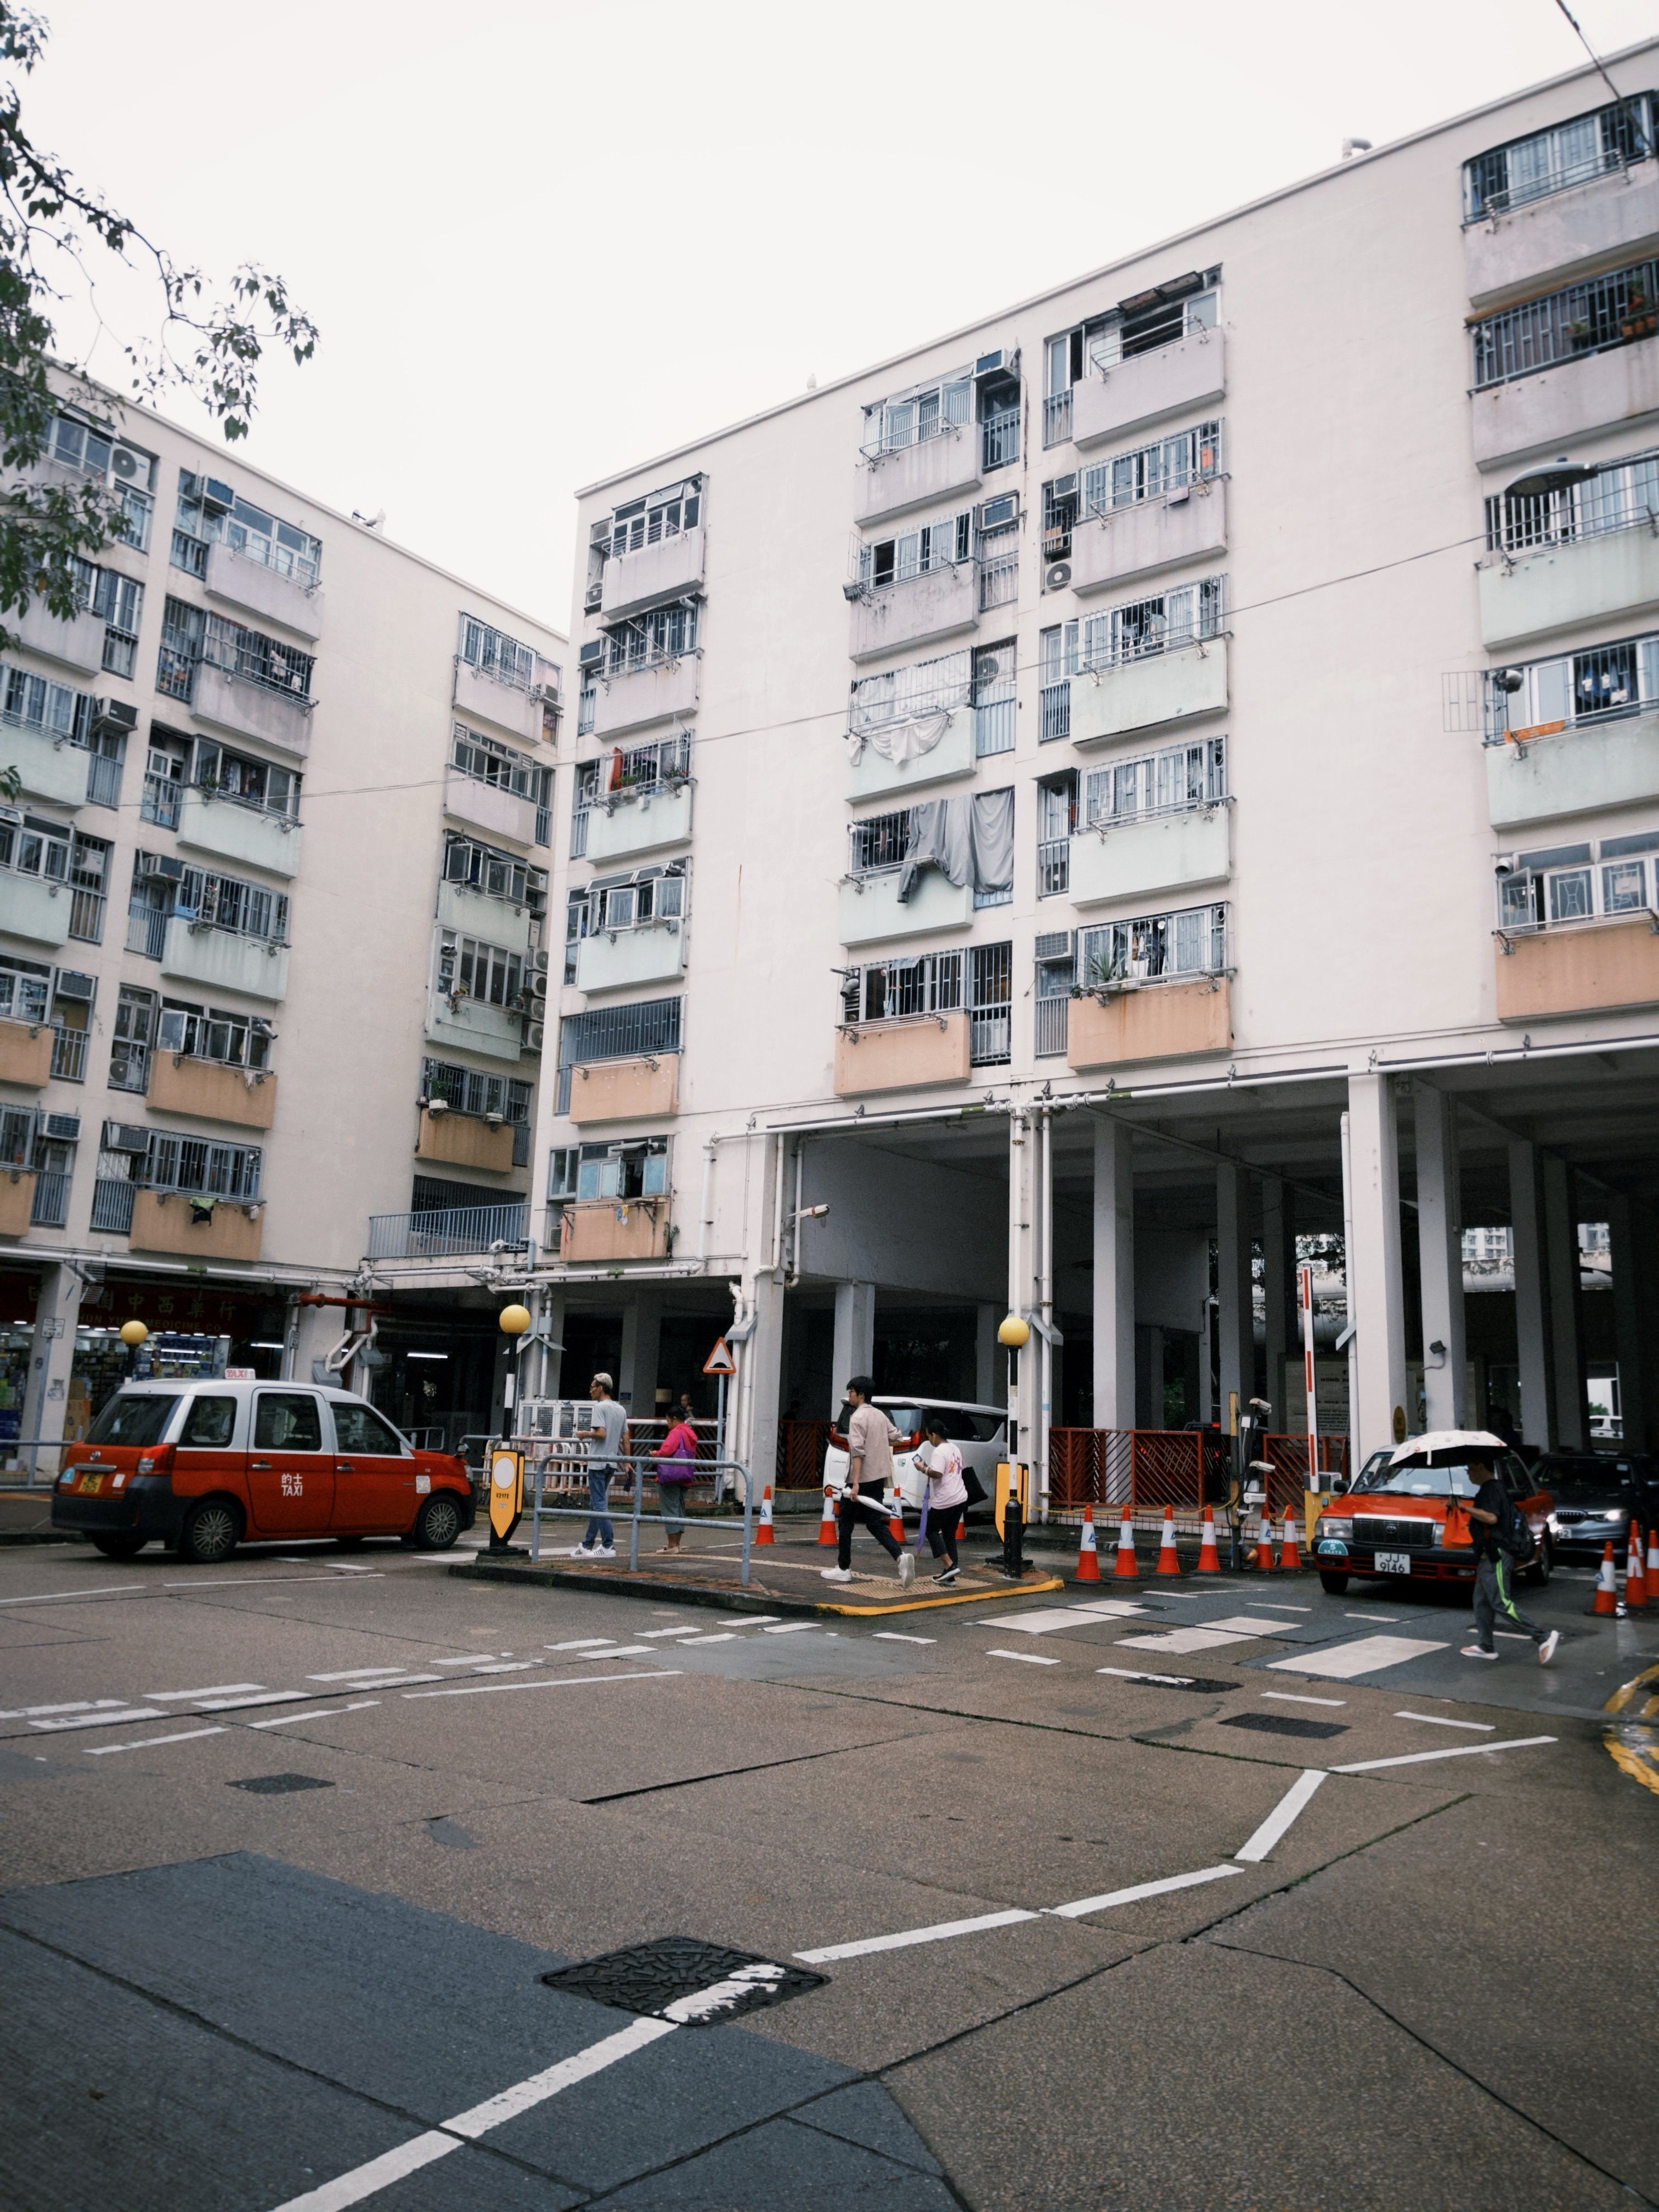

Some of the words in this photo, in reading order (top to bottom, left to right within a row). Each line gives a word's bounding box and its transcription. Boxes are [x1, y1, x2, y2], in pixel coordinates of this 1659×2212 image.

[227, 1370, 247, 1378] TAXI
[281, 1473, 303, 1484] 的士
[281, 1485, 303, 1497] TAXI
[1385, 1553, 1400, 1563] JJ
[1380, 1562, 1405, 1573] 9146
